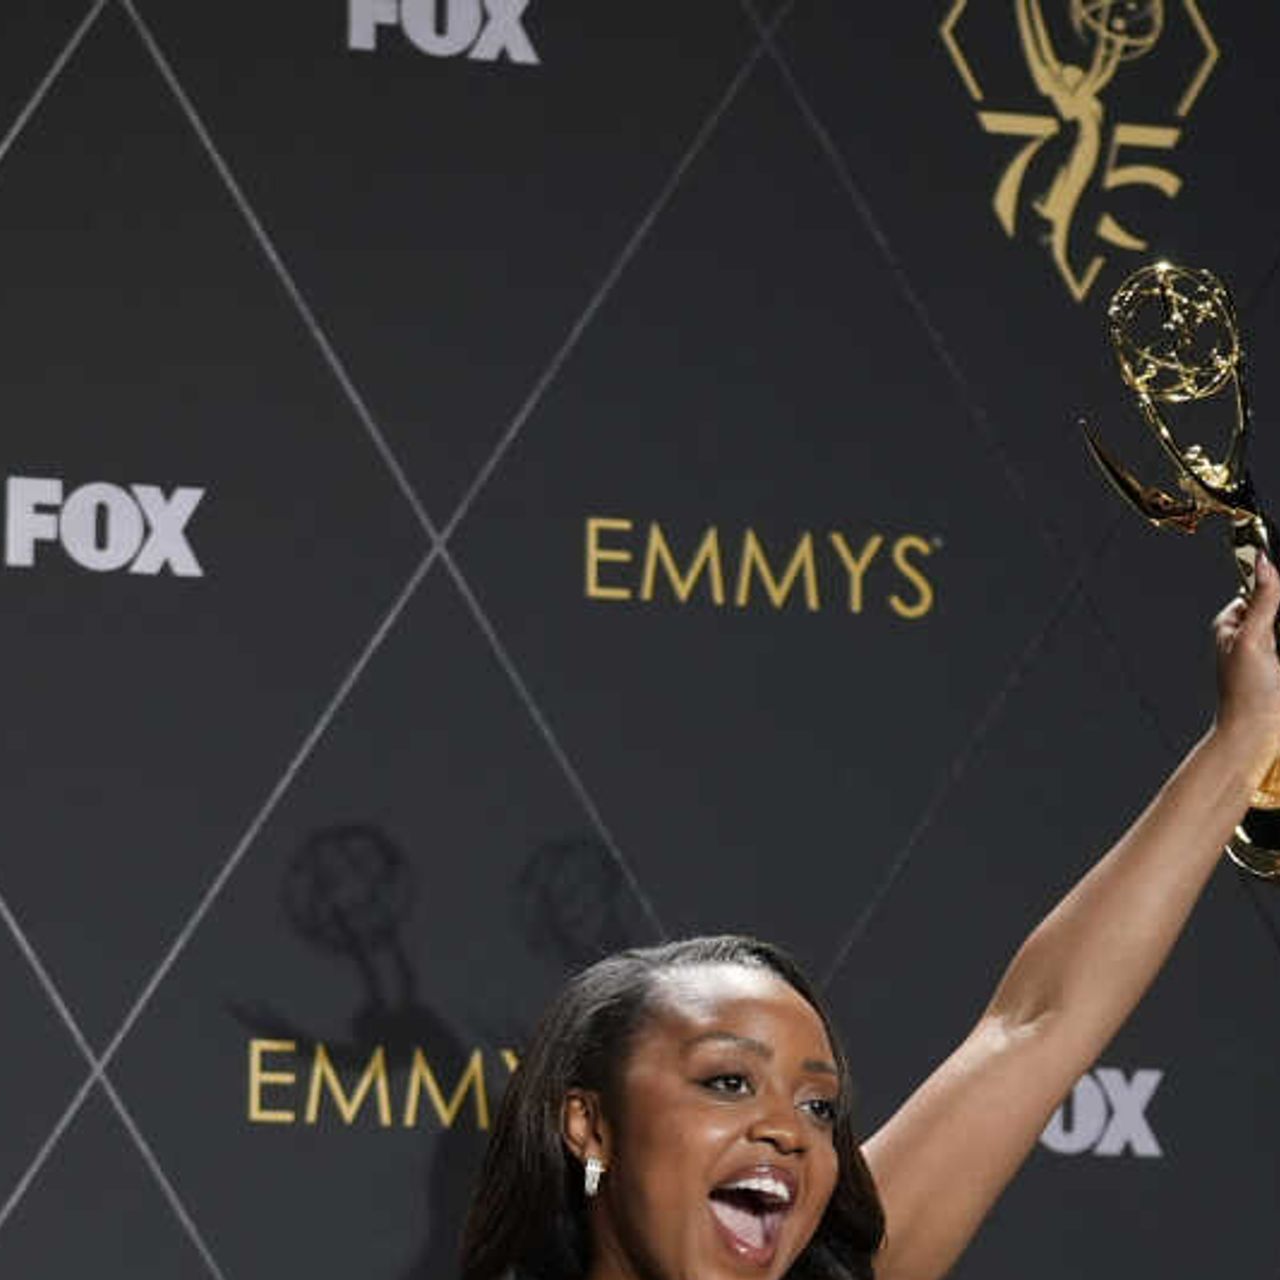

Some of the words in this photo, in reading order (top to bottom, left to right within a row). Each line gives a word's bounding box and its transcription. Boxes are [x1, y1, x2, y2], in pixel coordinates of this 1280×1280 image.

[347, 0, 540, 65] FOX
[4, 475, 206, 578] FOX
[585, 516, 934, 619] EMMYS
[247, 1038, 519, 1128] EMM
[1039, 1070, 1164, 1158] OX
